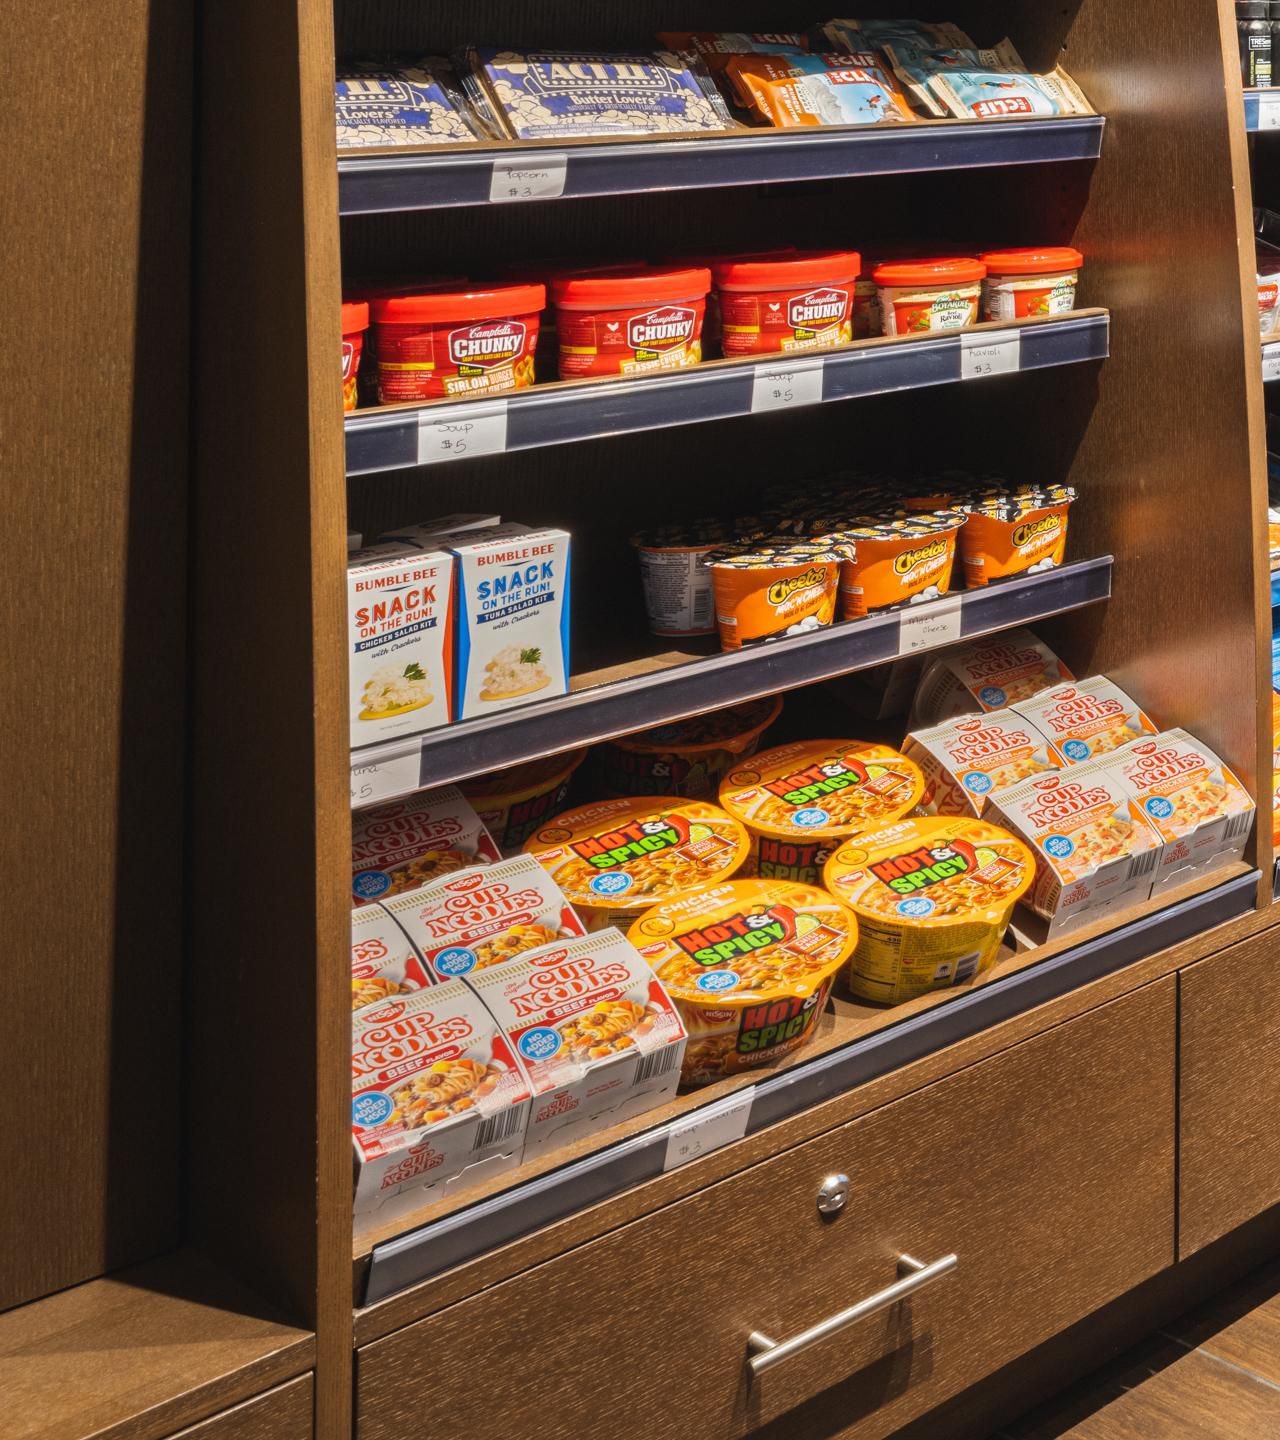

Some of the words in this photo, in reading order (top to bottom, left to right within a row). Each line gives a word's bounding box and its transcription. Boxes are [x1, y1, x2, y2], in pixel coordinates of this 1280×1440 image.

[551, 63, 605, 79] ACT
[616, 64, 647, 80] II
[571, 95, 609, 104] Butter
[611, 94, 655, 105] Lovers
[506, 167, 548, 181] Popcorn
[792, 302, 845, 322] CHUNKY
[940, 313, 962, 323] Ravioli
[454, 334, 522, 357] CHUNKY
[632, 321, 692, 342] CHUNKY
[448, 374, 488, 394] SIRLOIN
[433, 420, 474, 433] Soup
[1012, 513, 1060, 548] Cheetos
[477, 550, 529, 567] BUMBLE
[532, 544, 555, 556] BEE
[894, 539, 947, 575] Cheetos
[355, 572, 409, 592] BUMBLE
[414, 568, 437, 580] BEE
[477, 560, 553, 600] SNACK
[768, 567, 826, 605] Cheetos
[355, 585, 437, 627] SNACK
[483, 598, 498, 609] ON
[501, 592, 522, 605] THE
[526, 583, 550, 598] RUN!
[485, 610, 506, 620] TUNA
[508, 600, 533, 614] SALAD
[535, 595, 547, 605] KIT
[360, 634, 392, 649] CHICKEN
[394, 623, 418, 640] SALAD
[420, 619, 433, 632] KIT
[361, 625, 376, 638] ON
[380, 619, 402, 632] THE
[406, 607, 433, 623] RUN!
[493, 619, 510, 630] with
[512, 610, 539, 624] Crackers
[372, 647, 389, 659] with
[391, 635, 421, 652] Crackers
[1129, 753, 1205, 790] NOODLES
[1136, 749, 1178, 772] CUP
[766, 767, 824, 797] HOT
[783, 771, 860, 805] SPICY
[1037, 784, 1081, 806] CUP
[1154, 775, 1190, 794] CHICKEN
[1028, 787, 1111, 828] NOODLES
[1054, 811, 1093, 832] CHICKEN
[577, 823, 642, 857] HOT
[590, 828, 679, 868] SPICY
[872, 849, 932, 888] HOT
[889, 855, 969, 894] SPICY
[445, 884, 509, 912] CUP
[659, 885, 734, 913] CHICKEN
[426, 889, 544, 938] NOODLES
[467, 922, 501, 938] BEEF
[676, 916, 746, 952] HOT
[693, 922, 785, 966] SPICY
[529, 958, 594, 988] CUP
[510, 964, 630, 1017] NOODLES
[553, 1000, 587, 1016] BEEF
[362, 1013, 434, 1048] CUP
[387, 1059, 423, 1078] BEEF
